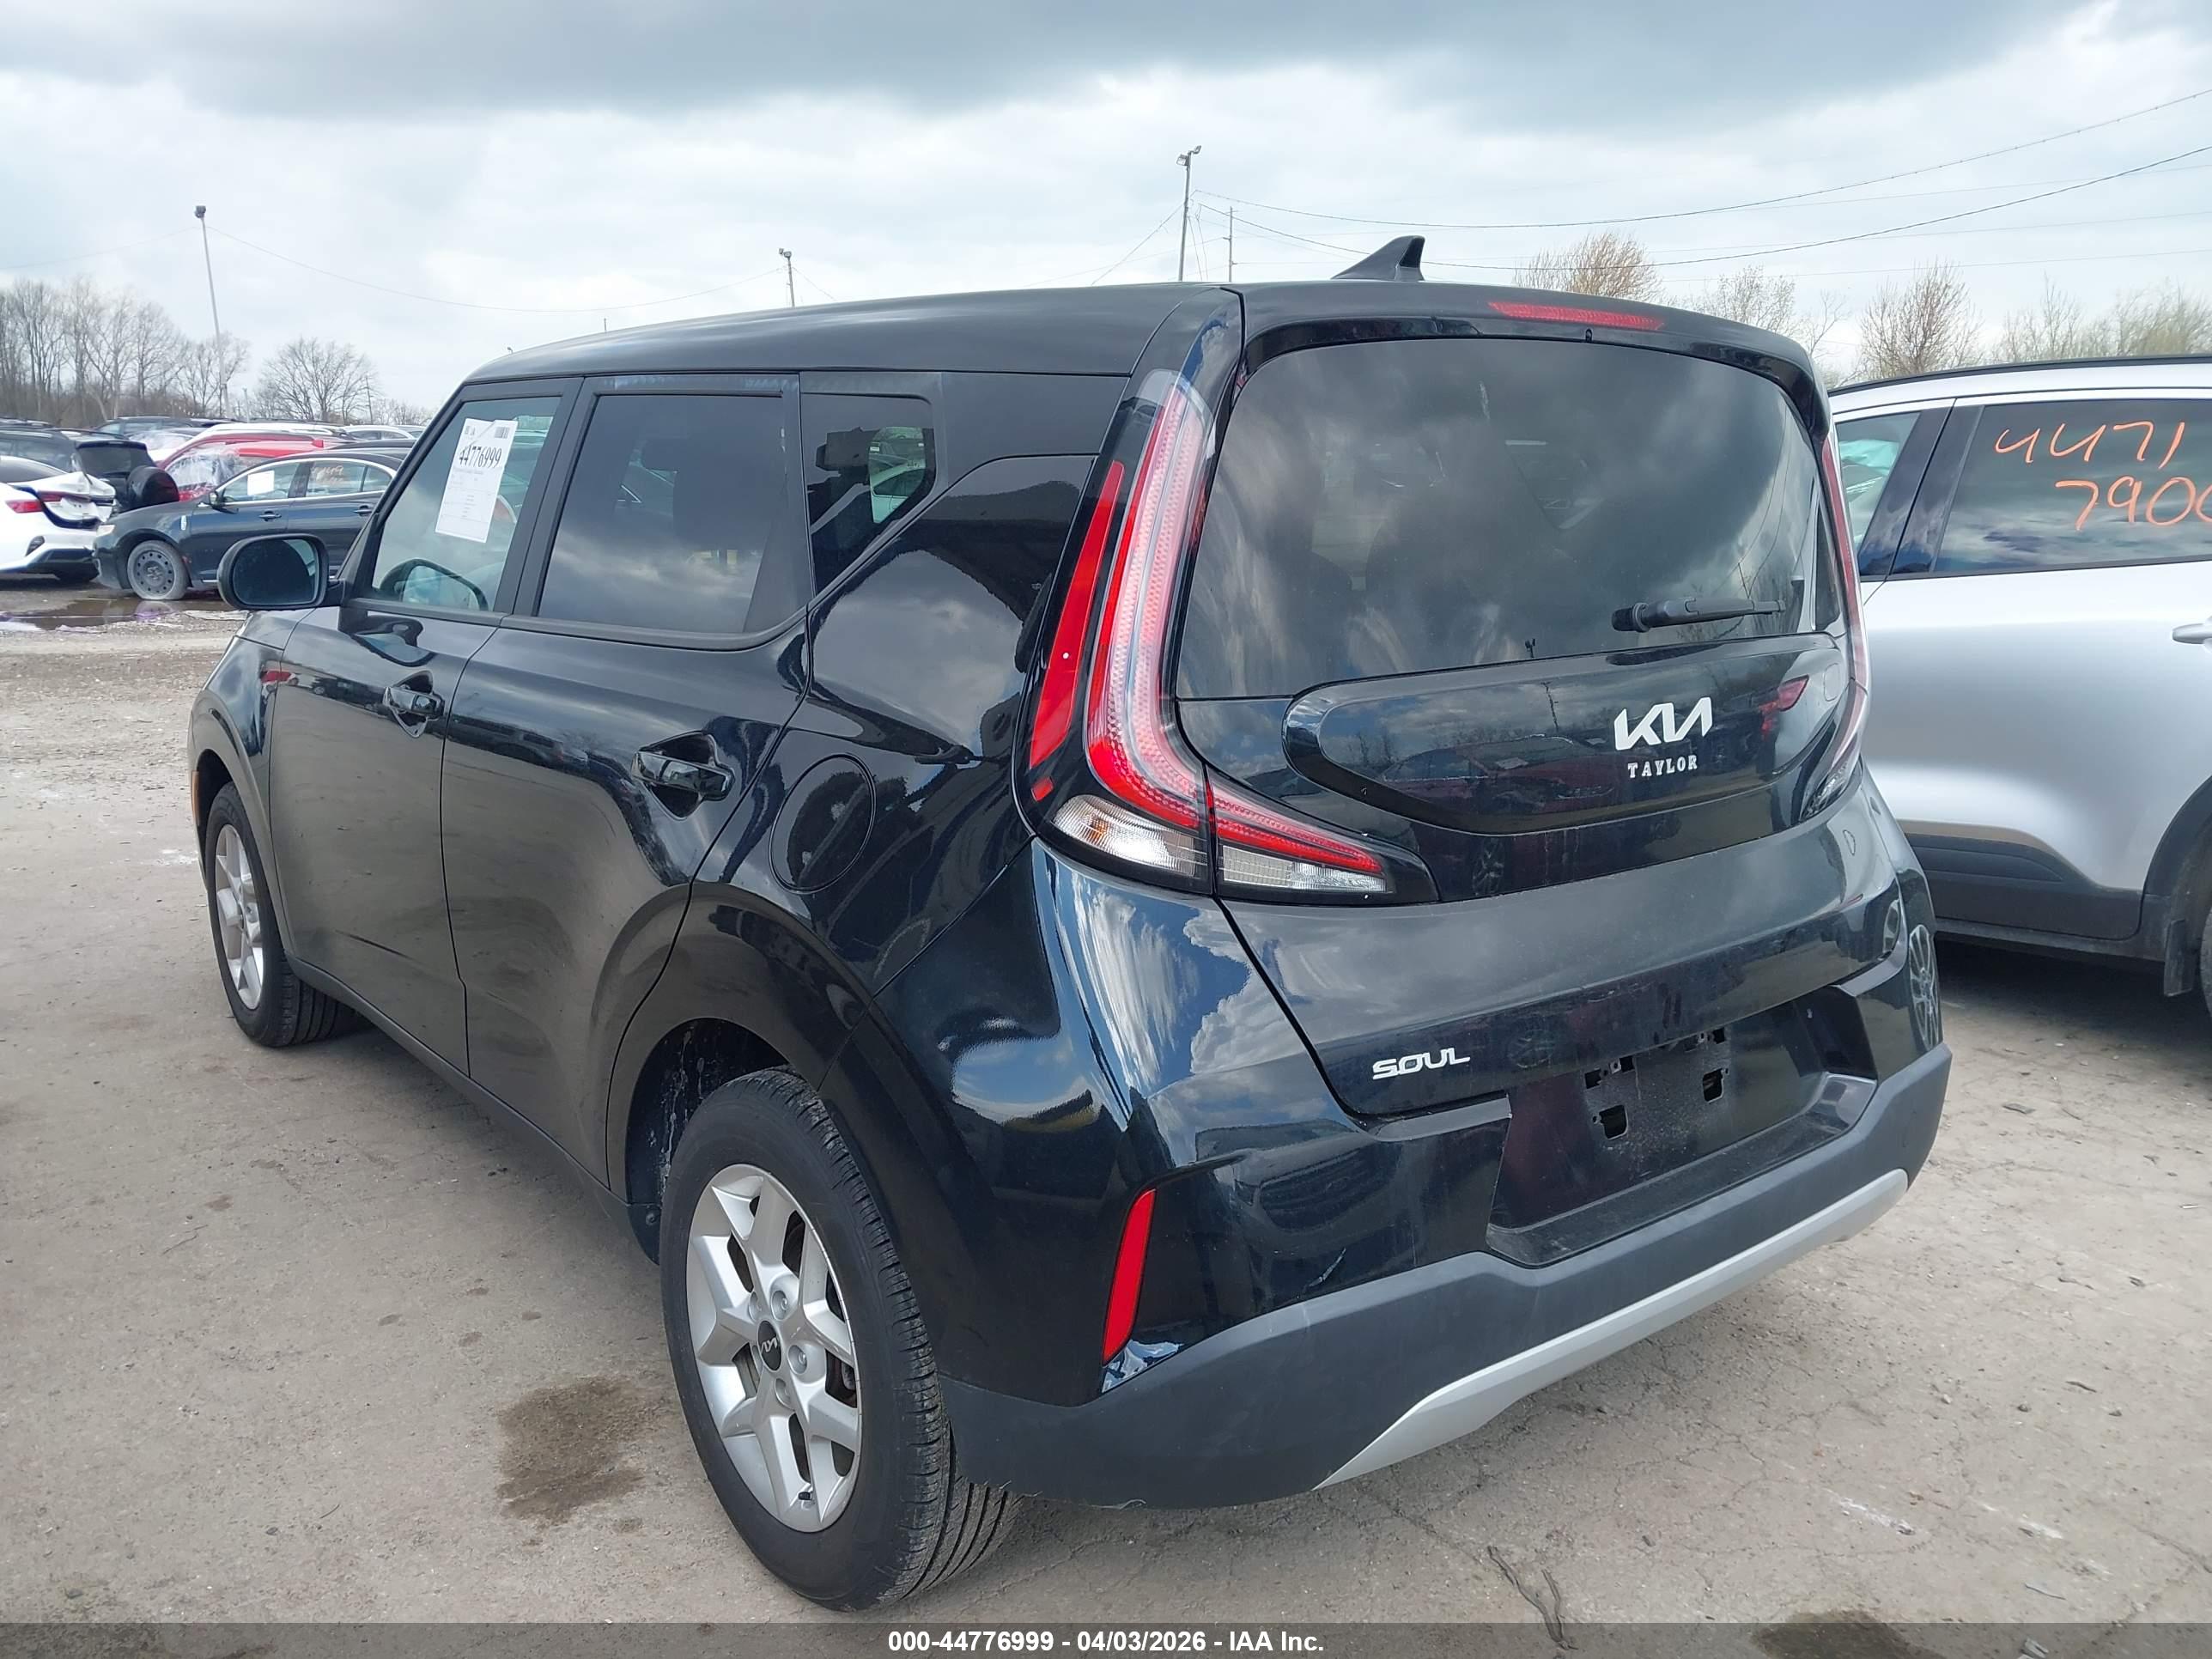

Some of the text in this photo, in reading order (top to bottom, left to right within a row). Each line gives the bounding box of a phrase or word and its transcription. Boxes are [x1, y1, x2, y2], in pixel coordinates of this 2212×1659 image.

[459, 445, 502, 468] 44776999
[1994, 420, 2185, 470] 4471
[1613, 696, 1713, 750] KIA
[1627, 755, 1698, 779] TAYLOR
[1372, 1047, 1471, 1080] SOUL
